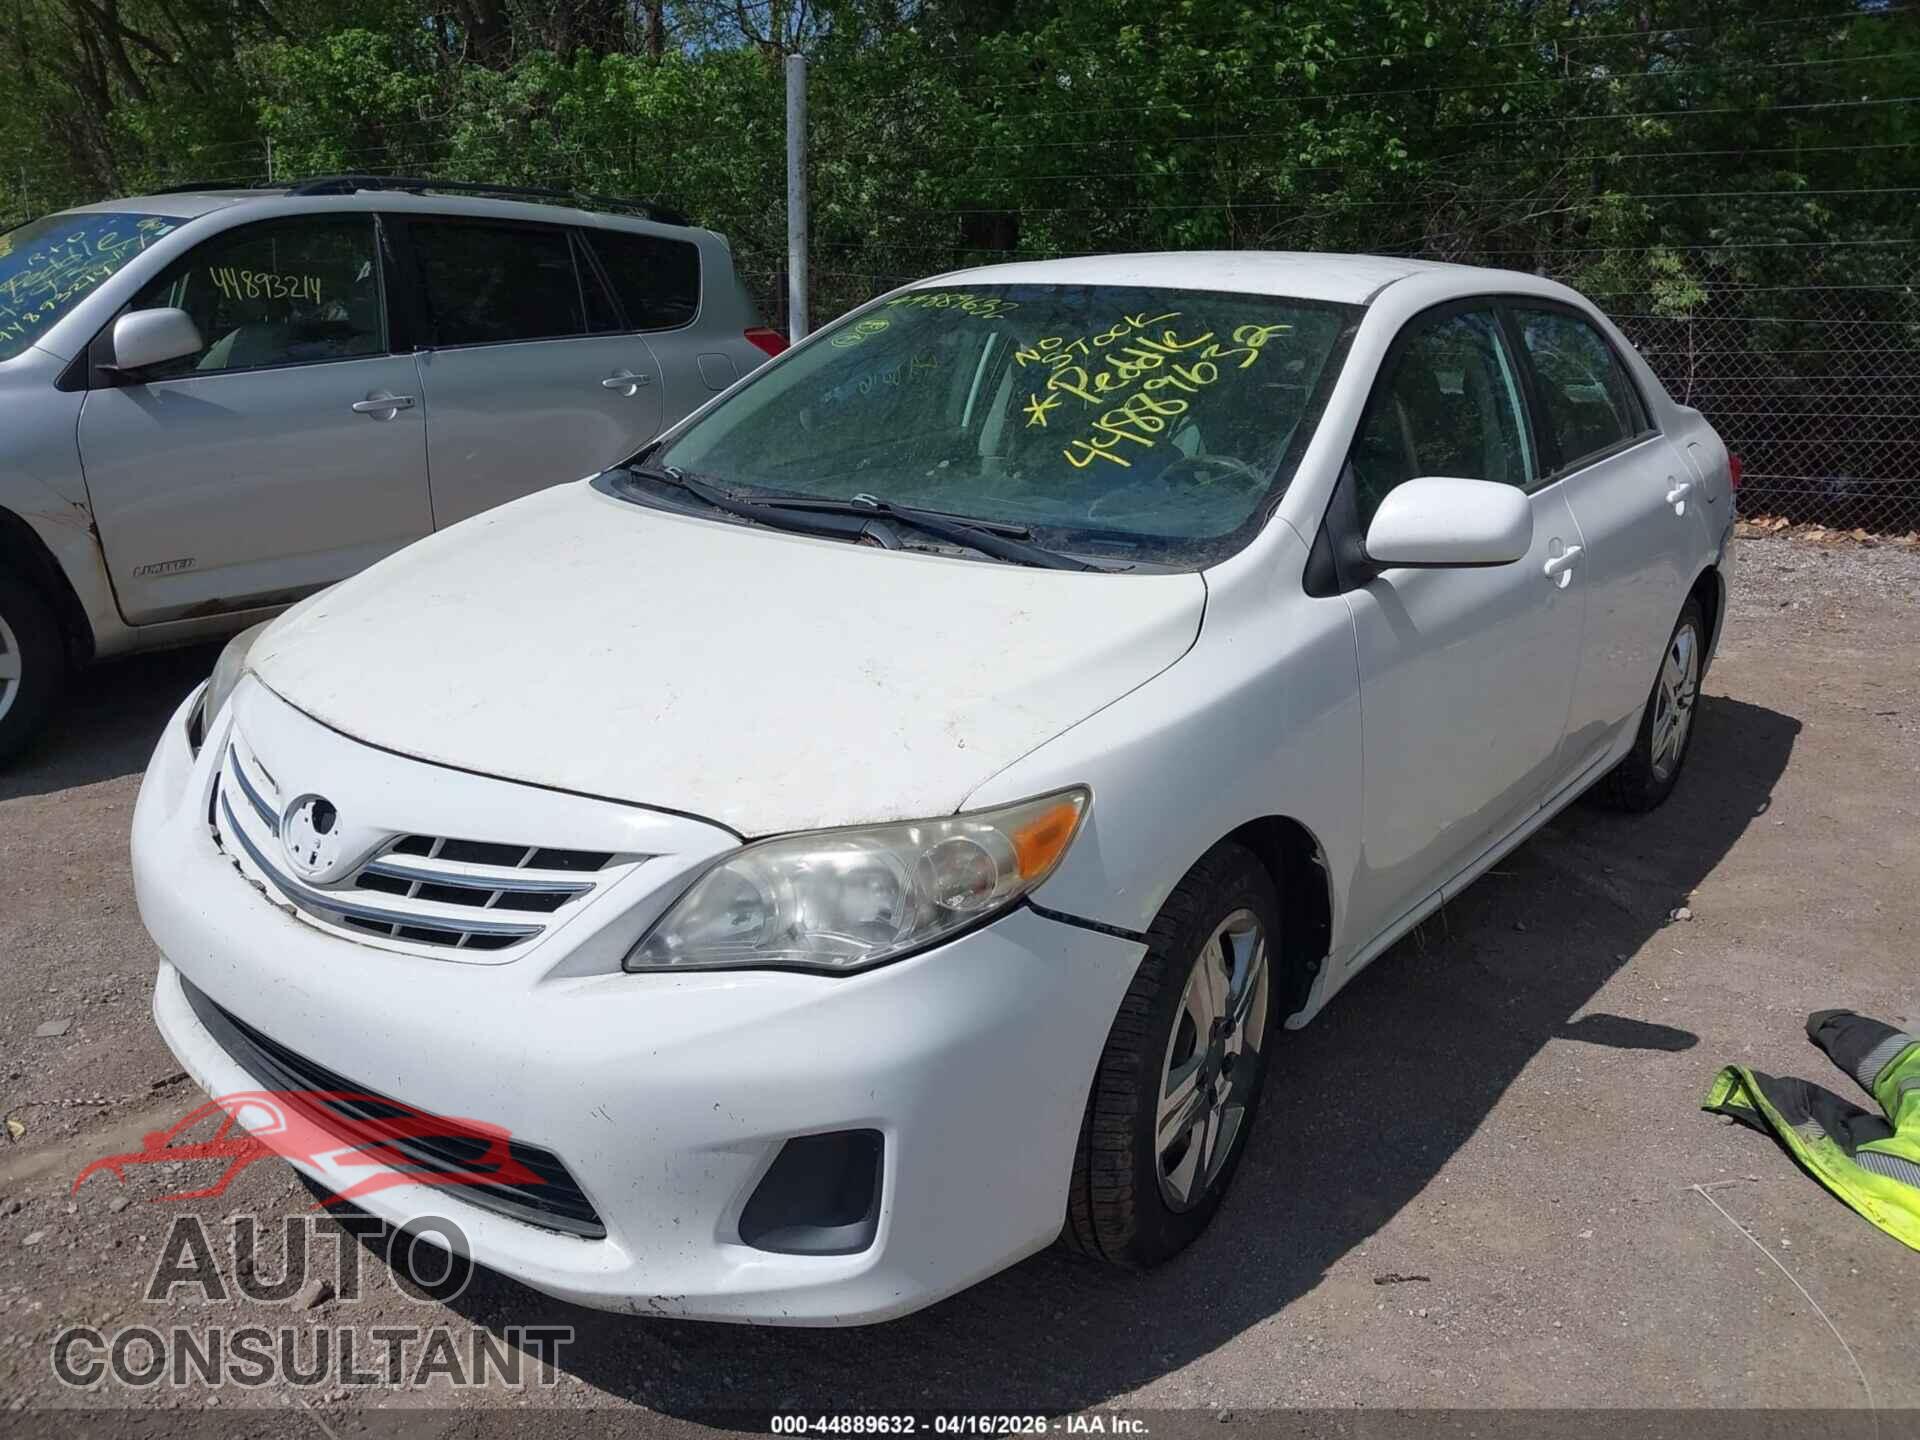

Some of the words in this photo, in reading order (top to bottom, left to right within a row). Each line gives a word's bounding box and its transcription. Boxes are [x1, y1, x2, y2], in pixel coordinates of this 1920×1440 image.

[209, 266, 321, 305] 44893214
[1015, 336, 1063, 368] NO
[1041, 312, 1183, 370] STOCK
[1063, 325, 1295, 468] 44889632
